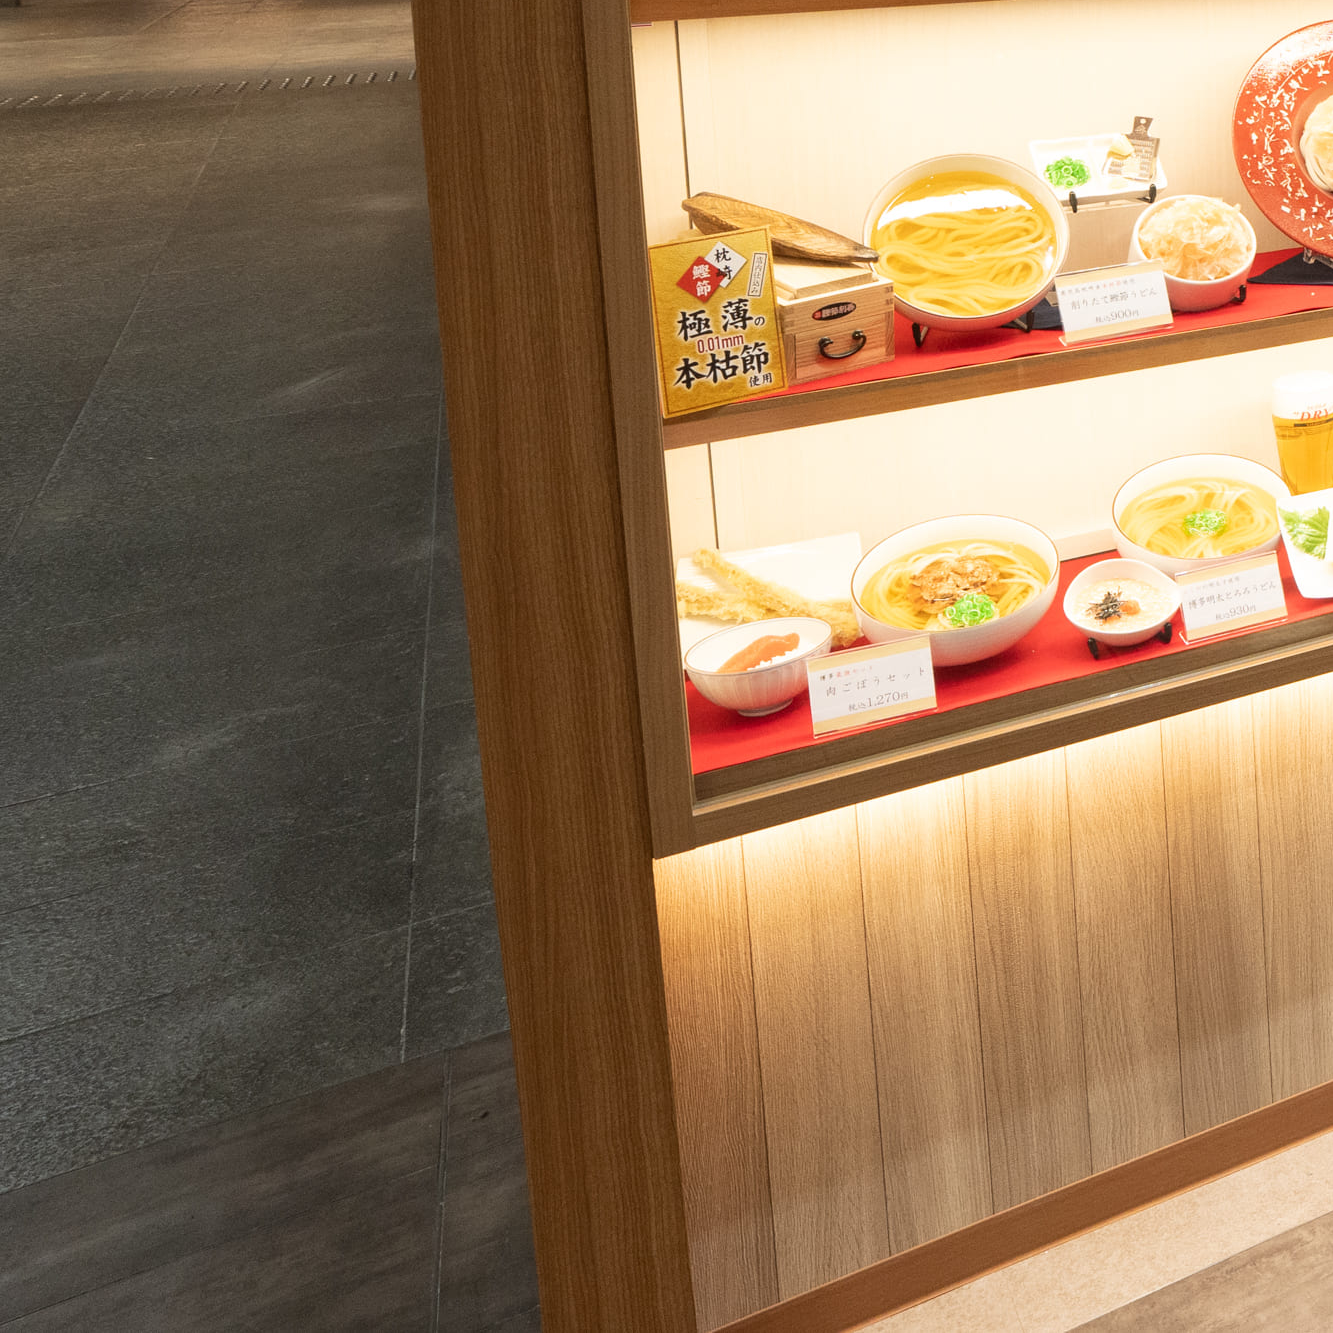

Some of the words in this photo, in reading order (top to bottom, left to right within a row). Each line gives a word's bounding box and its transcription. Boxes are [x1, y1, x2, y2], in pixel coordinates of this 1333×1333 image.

[714, 248, 732, 280] 枕崎
[692, 264, 711, 296] 鰹節
[1071, 288, 1158, 311] 削りたて鰹節うどん
[677, 298, 765, 342] 極薄の
[697, 335, 744, 353] 0.01mm
[674, 342, 769, 389] 本枯節
[749, 373, 773, 387] 使用
[1189, 581, 1276, 610] 博多明太とろろうどん
[826, 667, 925, 698] 肉ごぼうセット
[849, 691, 910, 712] 税込1,270円
